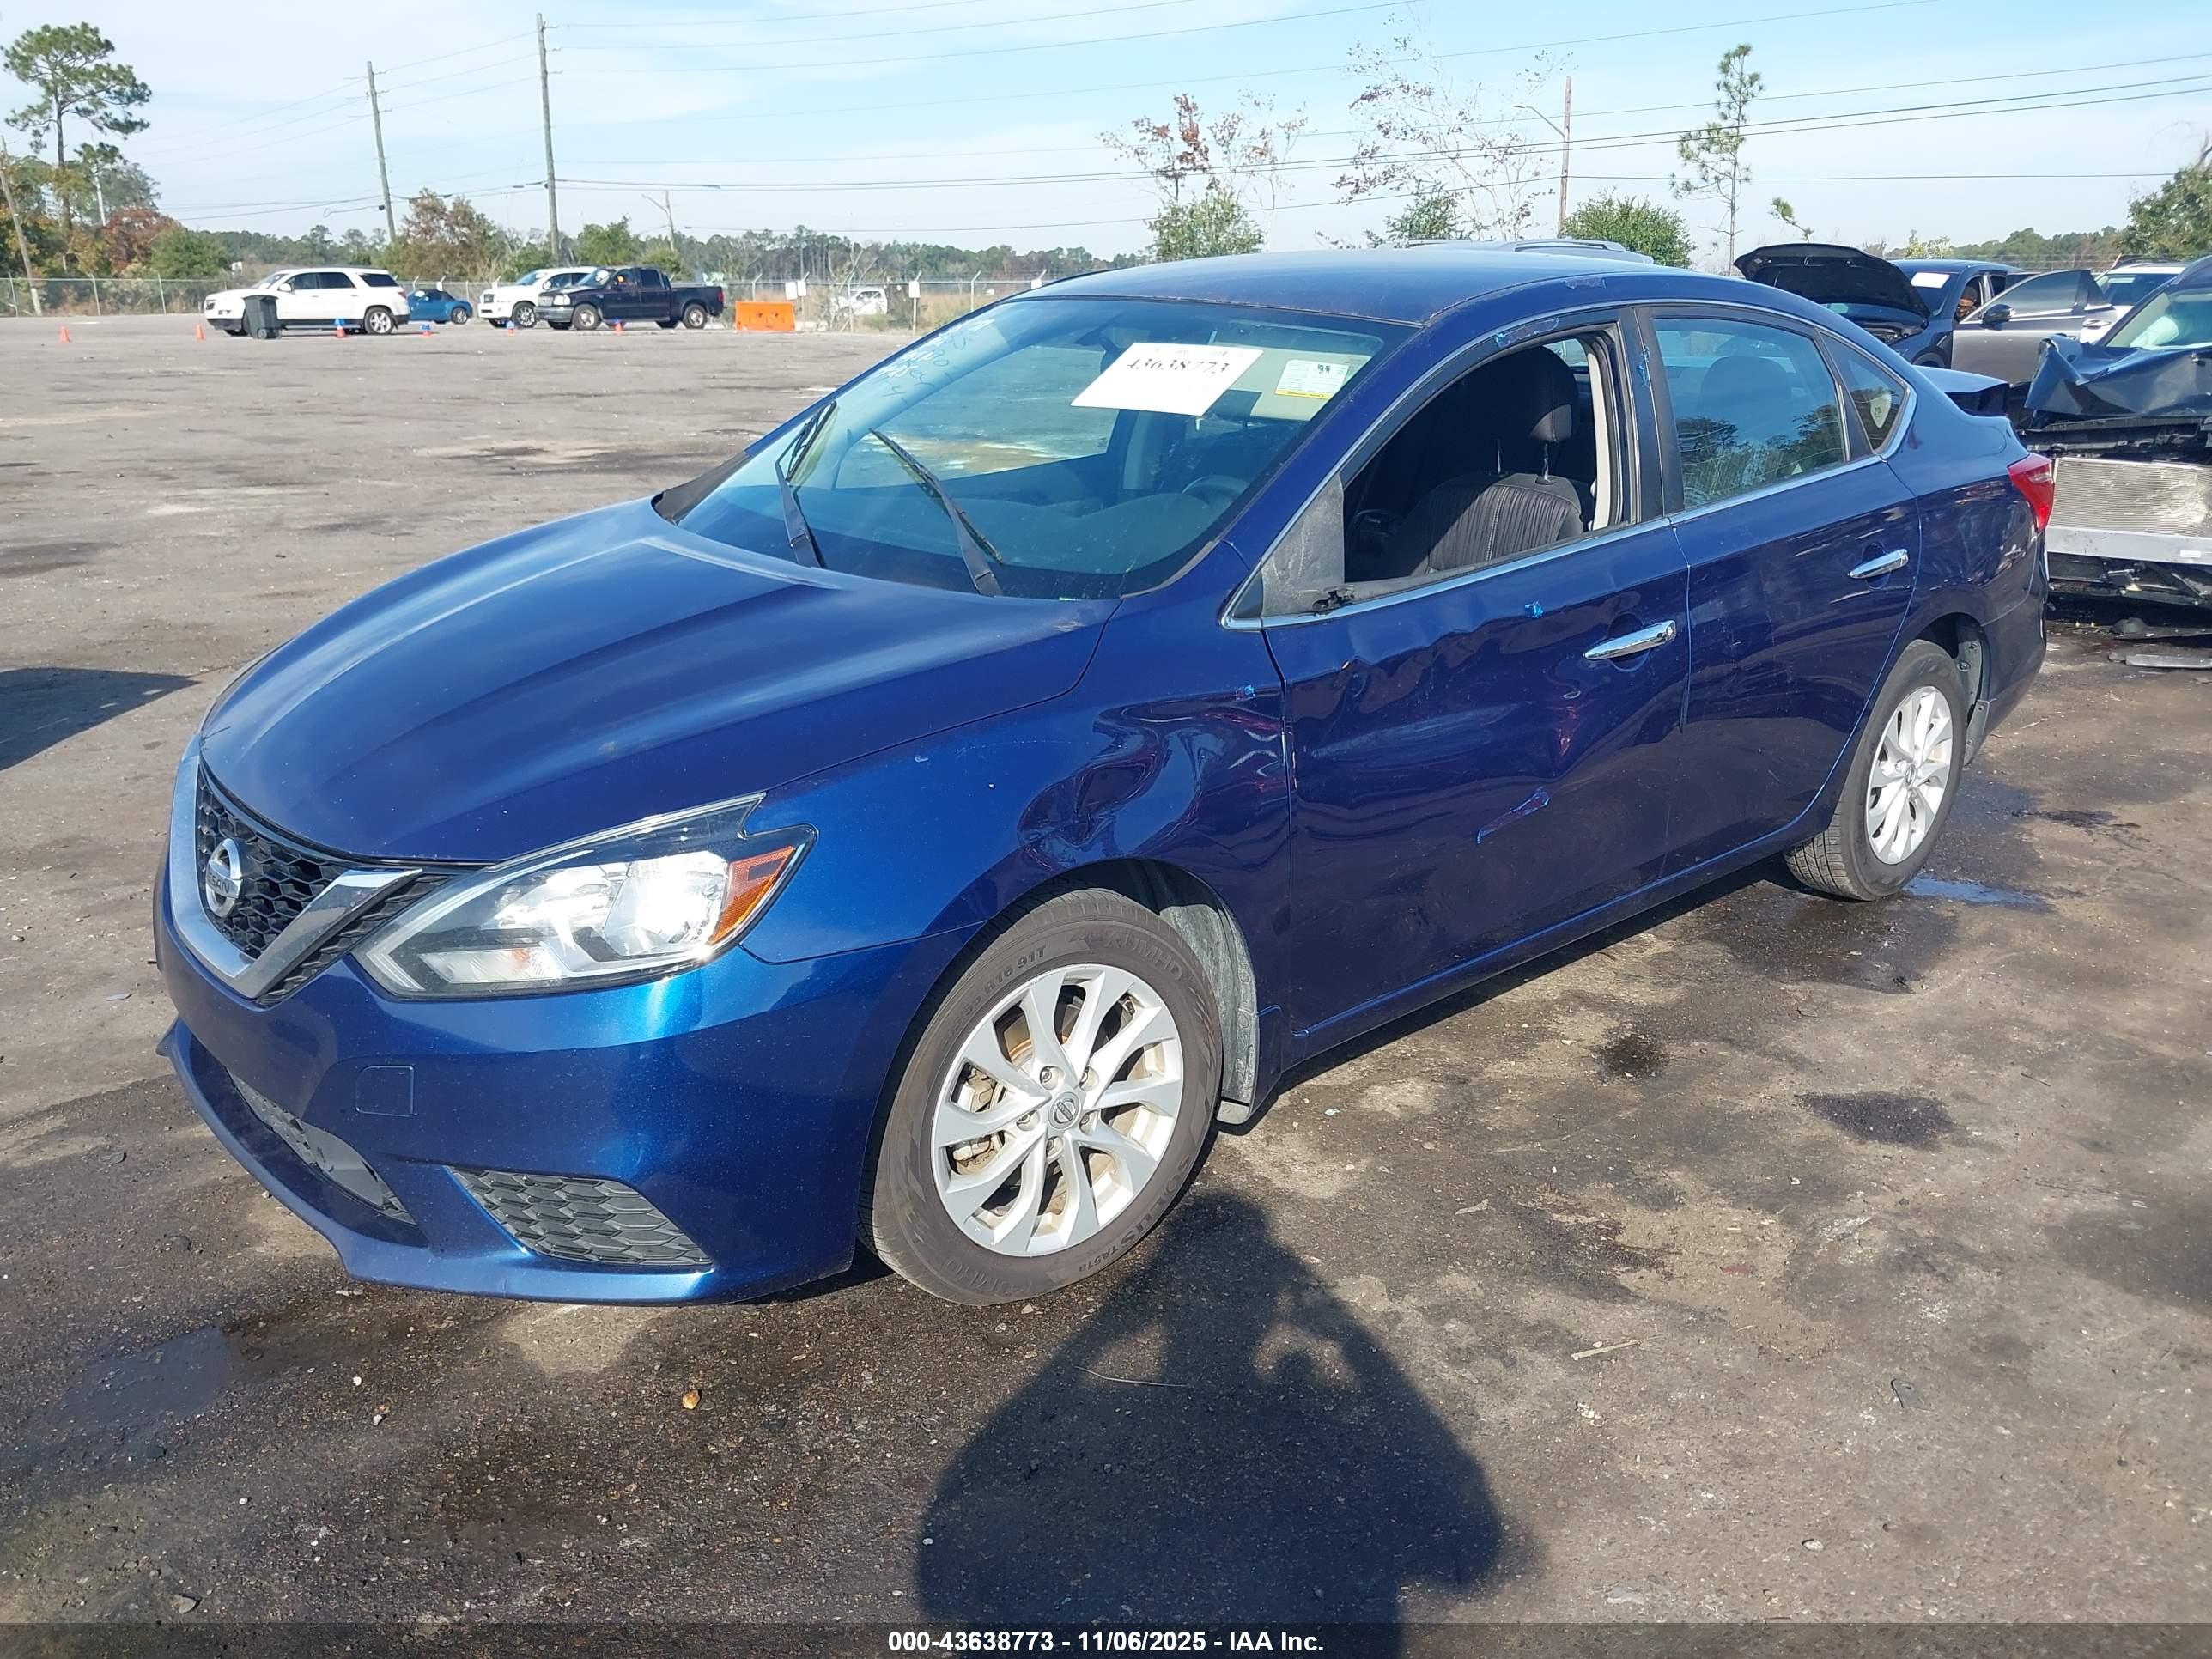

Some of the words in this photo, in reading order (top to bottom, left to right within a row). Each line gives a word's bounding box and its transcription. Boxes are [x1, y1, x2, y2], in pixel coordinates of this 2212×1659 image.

[1016, 945, 1048, 969] 91T
[1104, 931, 1183, 980] KUMHO
[1120, 1154, 1191, 1249] SOLUS
